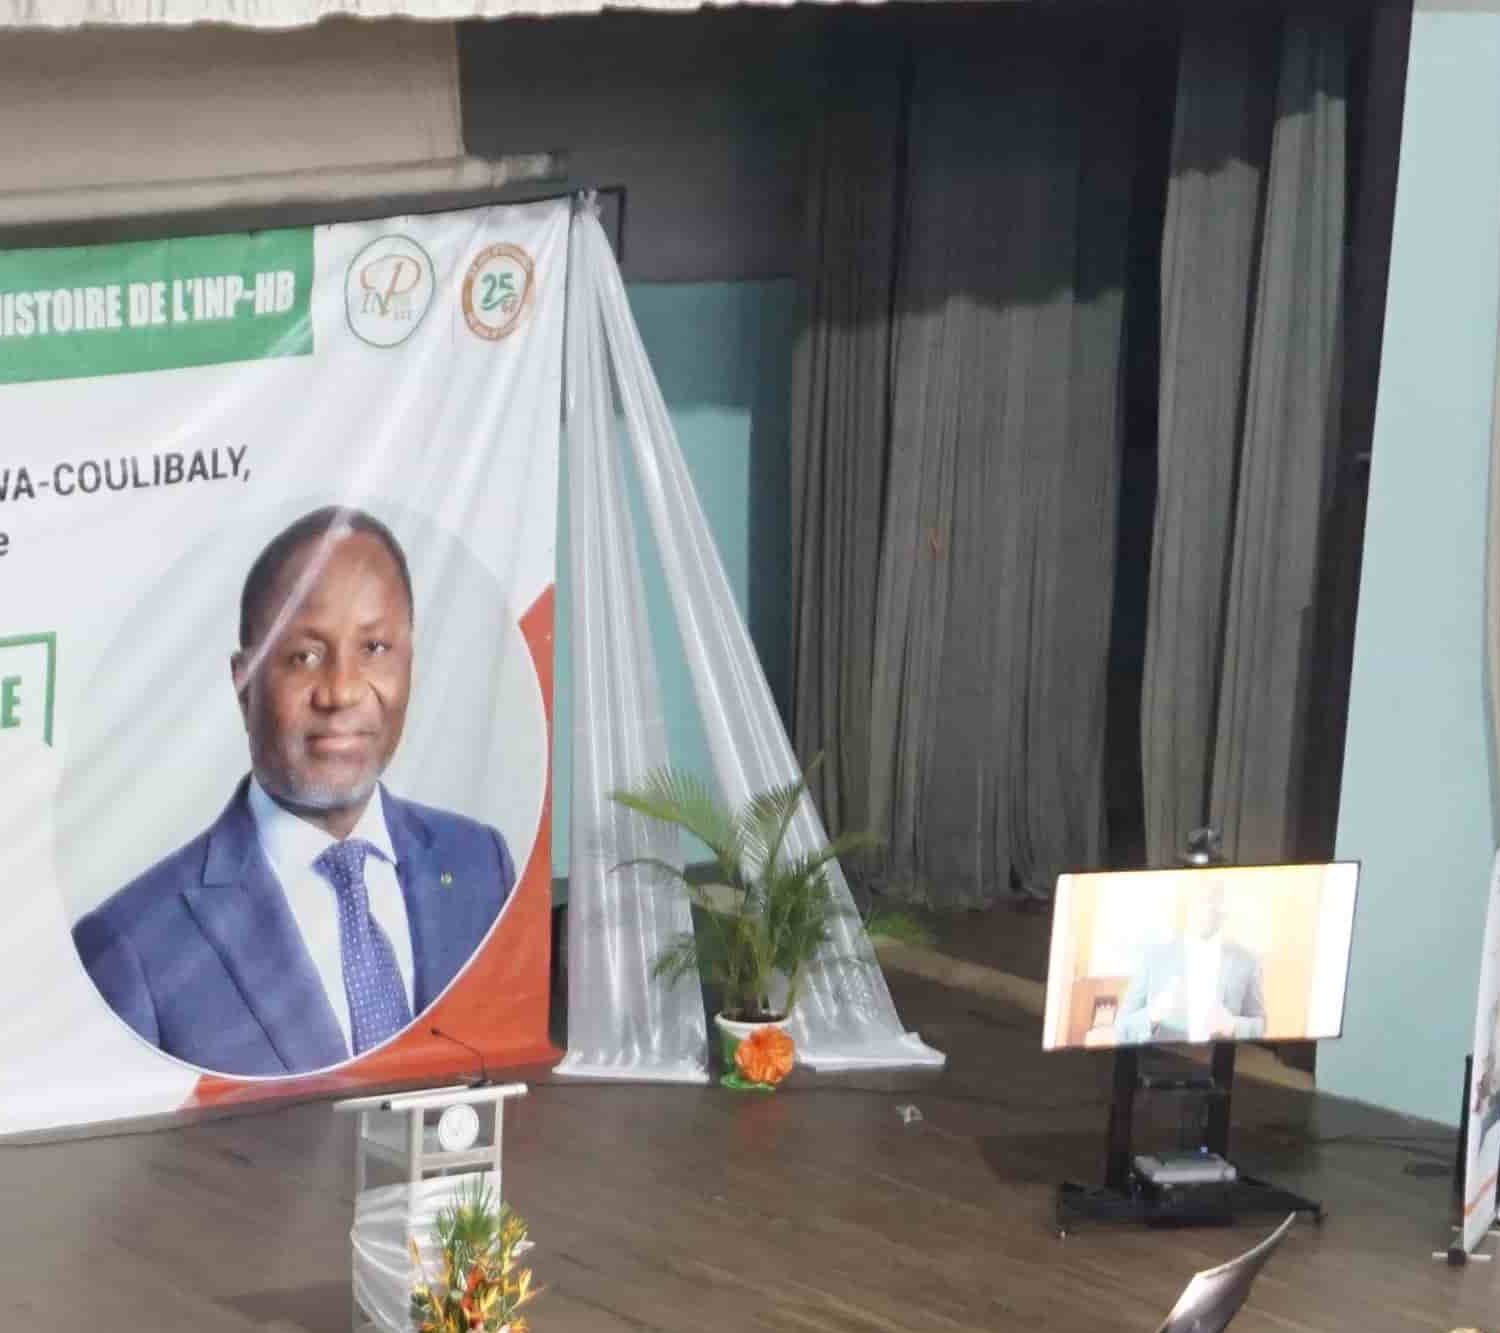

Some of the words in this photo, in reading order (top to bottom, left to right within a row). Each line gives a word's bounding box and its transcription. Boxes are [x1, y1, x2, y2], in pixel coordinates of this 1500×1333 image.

[130, 282, 167, 328] DE
[174, 272, 296, 324] L'INP-HB
[481, 273, 514, 304] 25
